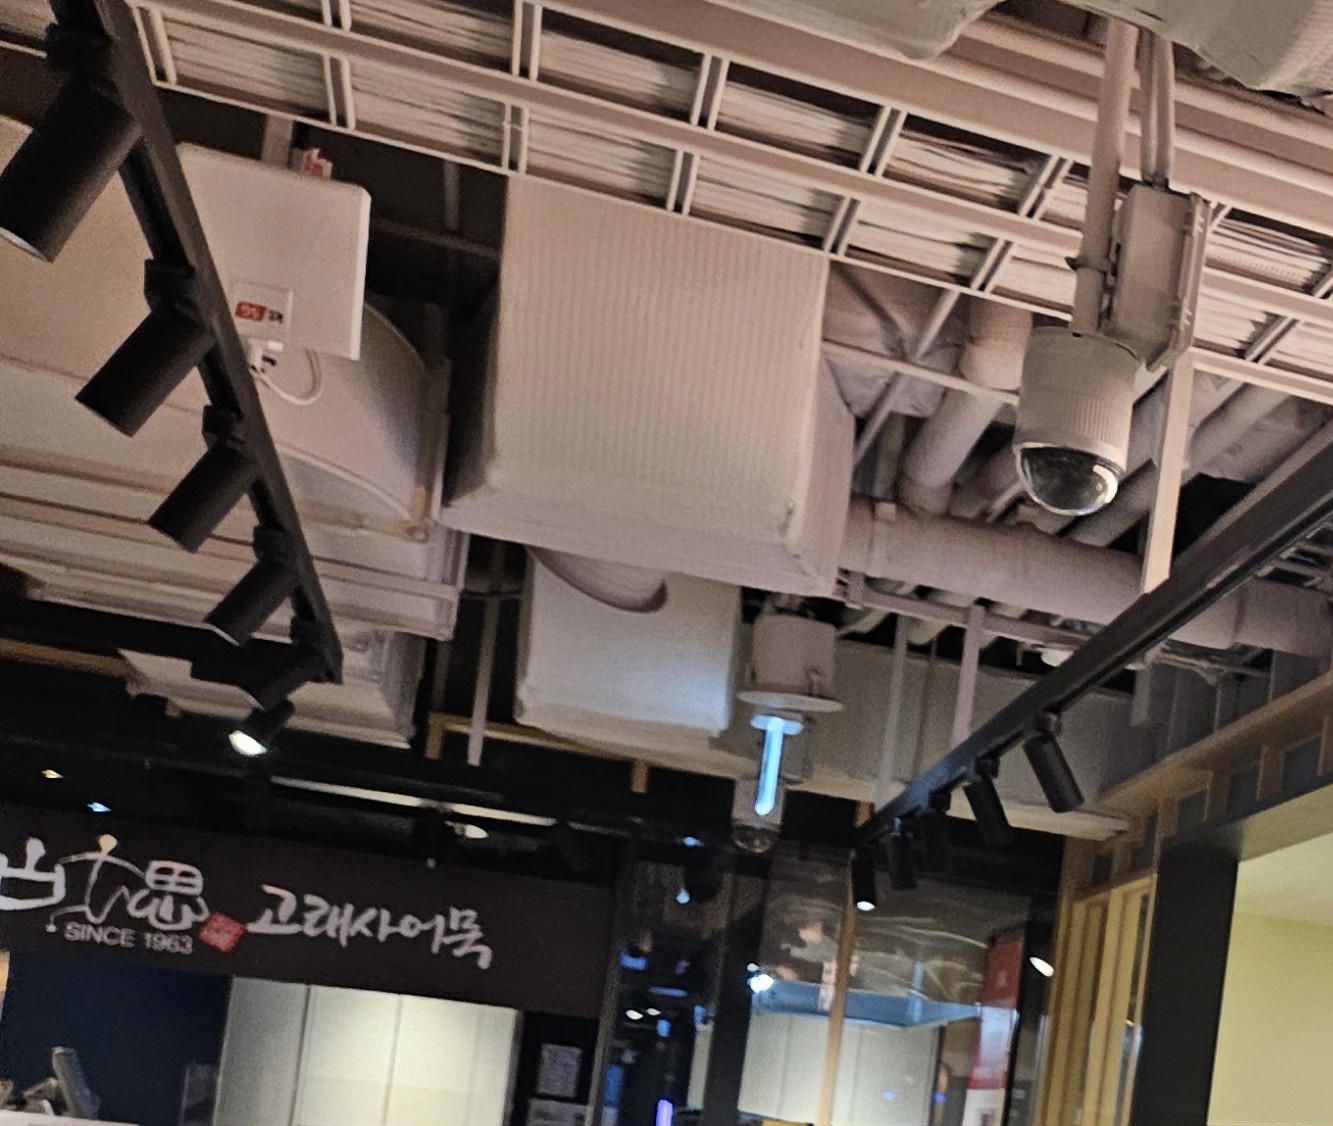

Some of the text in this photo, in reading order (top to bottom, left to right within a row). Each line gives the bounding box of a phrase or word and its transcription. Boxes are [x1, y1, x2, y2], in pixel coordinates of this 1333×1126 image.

[64, 921, 136, 948] SINCE
[143, 932, 193, 956] 1963
[247, 884, 493, 969] 고래사어묵
